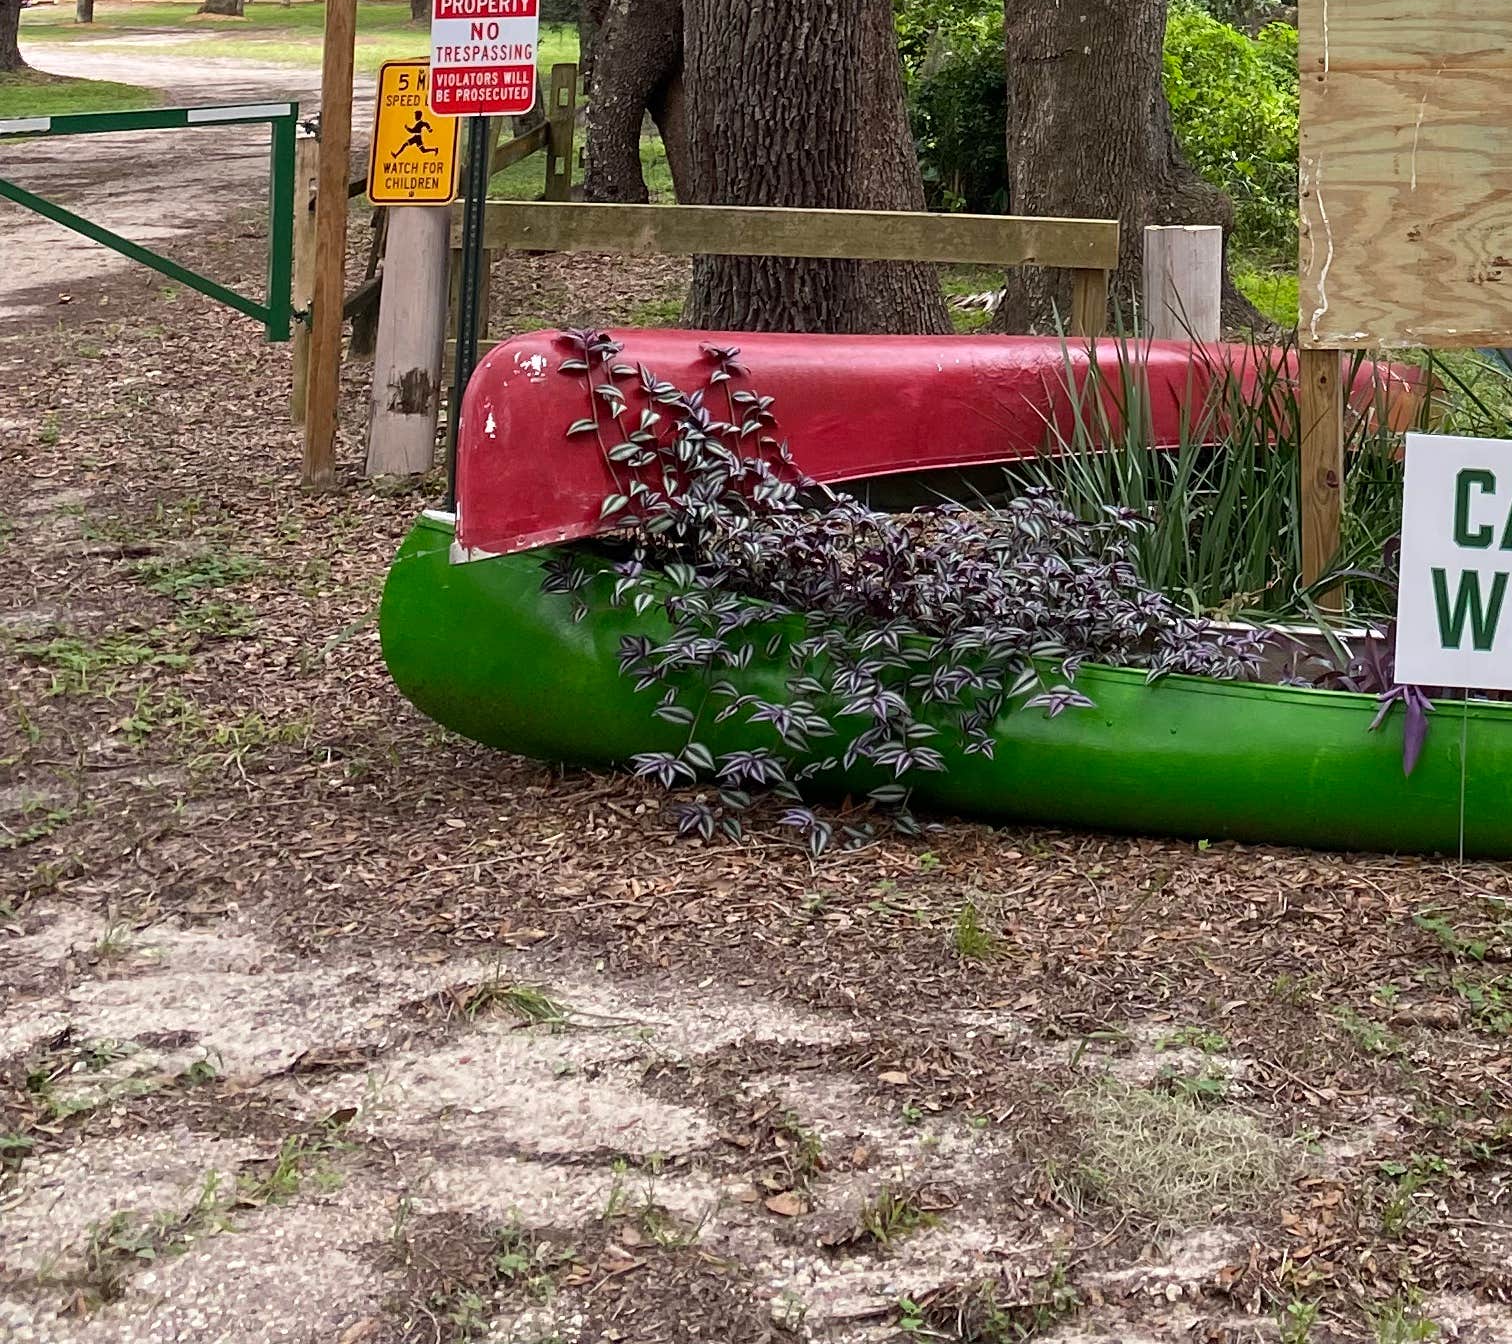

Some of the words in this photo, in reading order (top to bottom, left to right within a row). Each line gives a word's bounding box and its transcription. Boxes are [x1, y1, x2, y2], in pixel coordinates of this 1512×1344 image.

[470, 22, 500, 41] NO
[436, 43, 533, 63] TRESPASSING
[398, 73, 410, 91] 5
[436, 72, 499, 87] VIOLATORS
[503, 70, 530, 85] WILL
[386, 94, 421, 107] SPEED
[435, 88, 451, 103] BE
[455, 86, 529, 102] PROSECUTED
[383, 161, 419, 174] WATCH
[423, 161, 444, 174] FOR
[384, 177, 439, 189] CHILDREN
